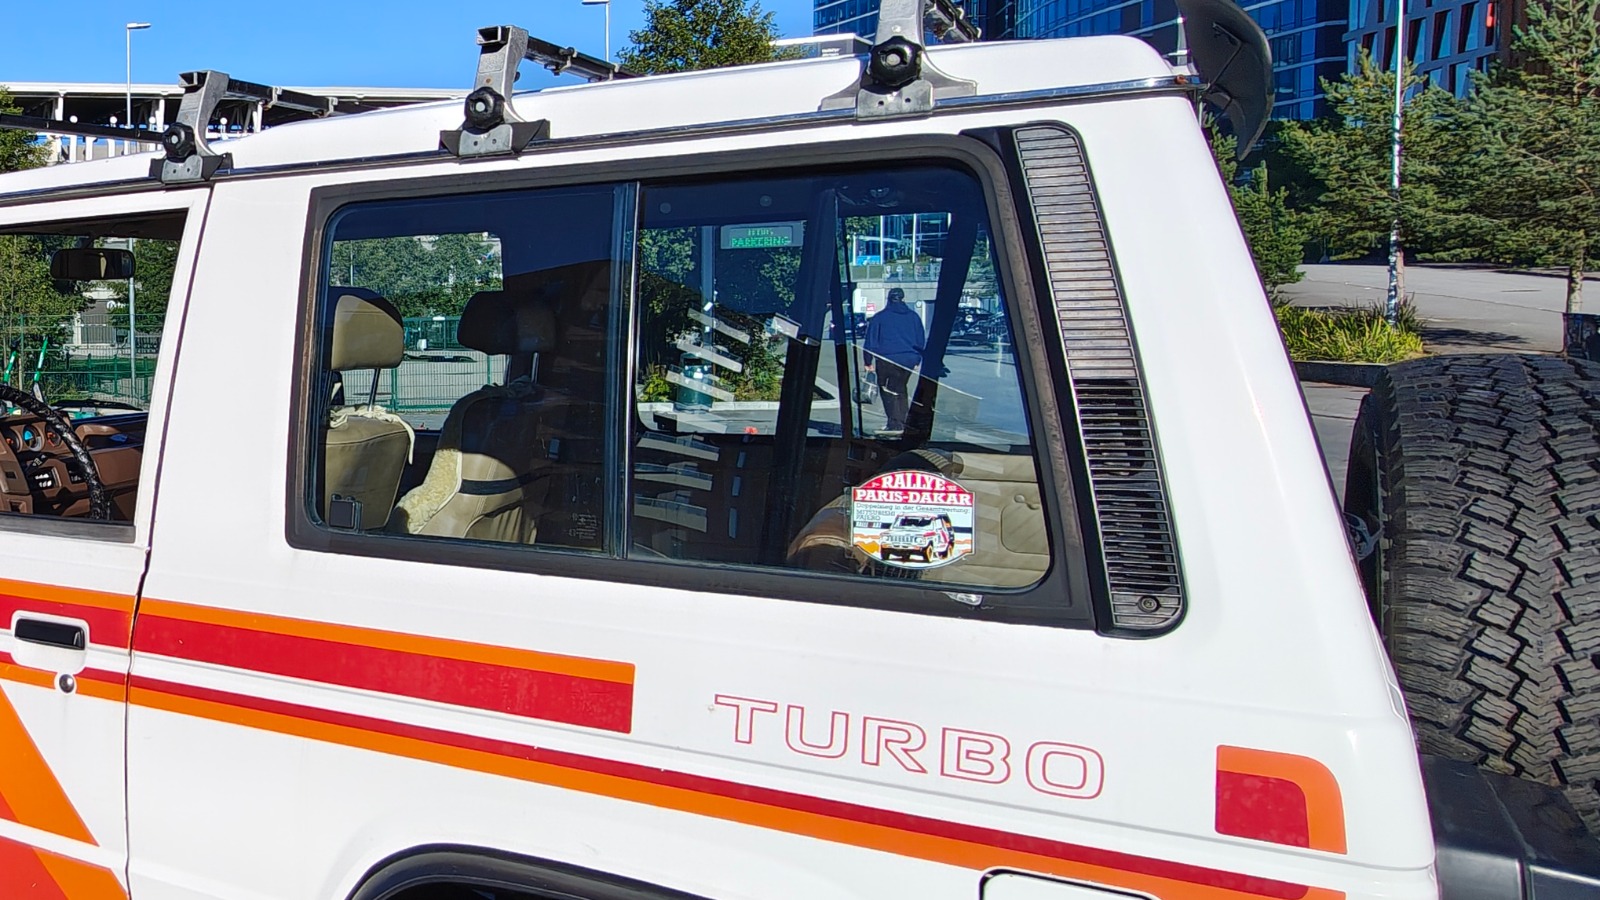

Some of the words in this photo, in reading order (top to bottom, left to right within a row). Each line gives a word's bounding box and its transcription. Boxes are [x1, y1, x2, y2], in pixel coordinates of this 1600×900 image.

[881, 472, 945, 491] RALLYE
[855, 489, 972, 505] PARIS-DAKAR
[714, 694, 1104, 799] TURBO
